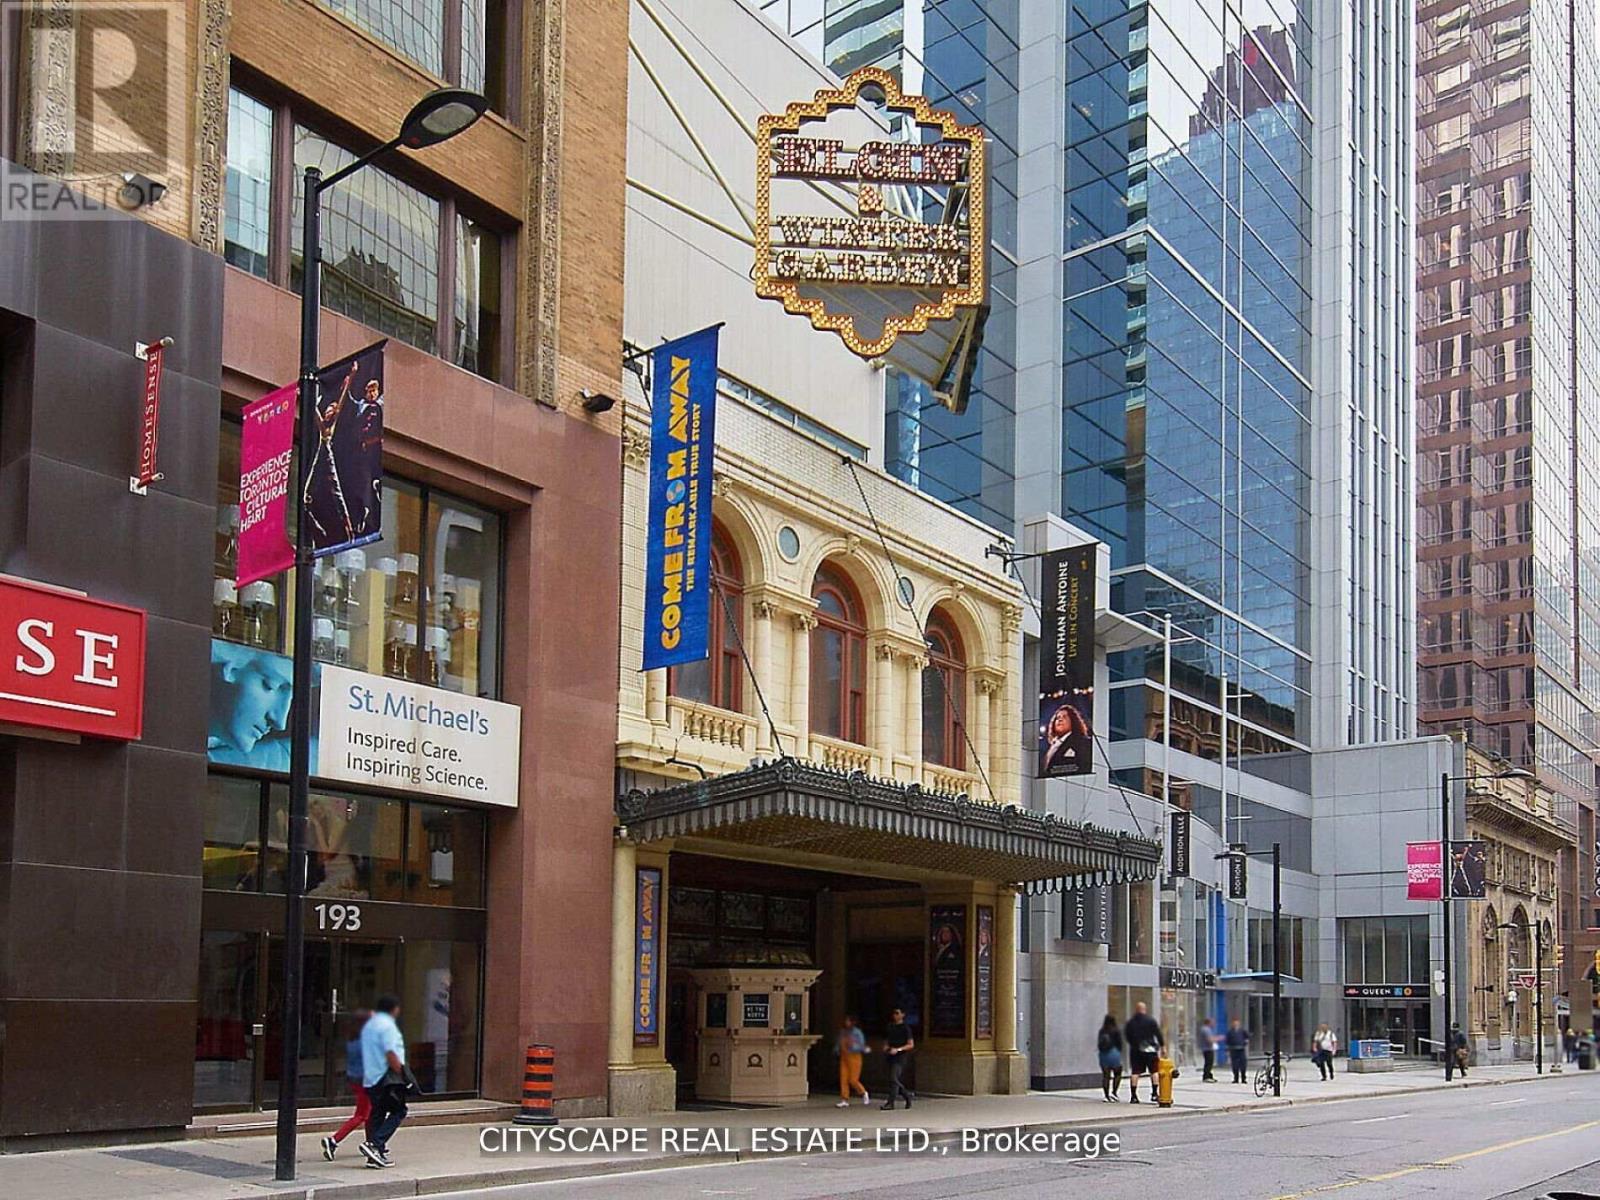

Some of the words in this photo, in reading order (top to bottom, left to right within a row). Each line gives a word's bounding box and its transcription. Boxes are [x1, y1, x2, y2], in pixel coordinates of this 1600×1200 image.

[777, 137, 963, 183] ELGIN
[859, 184, 884, 214] &
[776, 215, 963, 251] WINTER
[776, 250, 961, 284] GARDEN
[141, 351, 158, 476] HOMESENSE
[668, 355, 691, 444] AWAY
[692, 403, 701, 441] STORY
[241, 449, 292, 488] EXPERIENCE
[690, 444, 699, 477] TRUE
[240, 465, 289, 503] TORONTO'S
[246, 481, 288, 515] CULTURAL
[240, 505, 267, 533] HEART
[687, 480, 698, 566] REMARKABLE
[686, 568, 695, 592] THE
[1056, 561, 1068, 612] ANTOINE
[1069, 576, 1079, 621] CONCERT
[661, 551, 684, 650] COME
[1055, 616, 1067, 677] JONATHAN
[1068, 636, 1077, 658] LIVE
[1069, 623, 1077, 634] IN
[348, 685, 379, 714] St.
[383, 692, 489, 735] Michael's
[347, 727, 417, 754] Inspired
[421, 740, 462, 763] Care.
[347, 752, 421, 784] Inspiring
[425, 765, 488, 791] Science.
[1177, 836, 1185, 872] ADDITION
[1234, 864, 1242, 895] ADDITION
[314, 904, 362, 931] 193
[642, 876, 654, 922] AWAY
[640, 977, 651, 1028] COME
